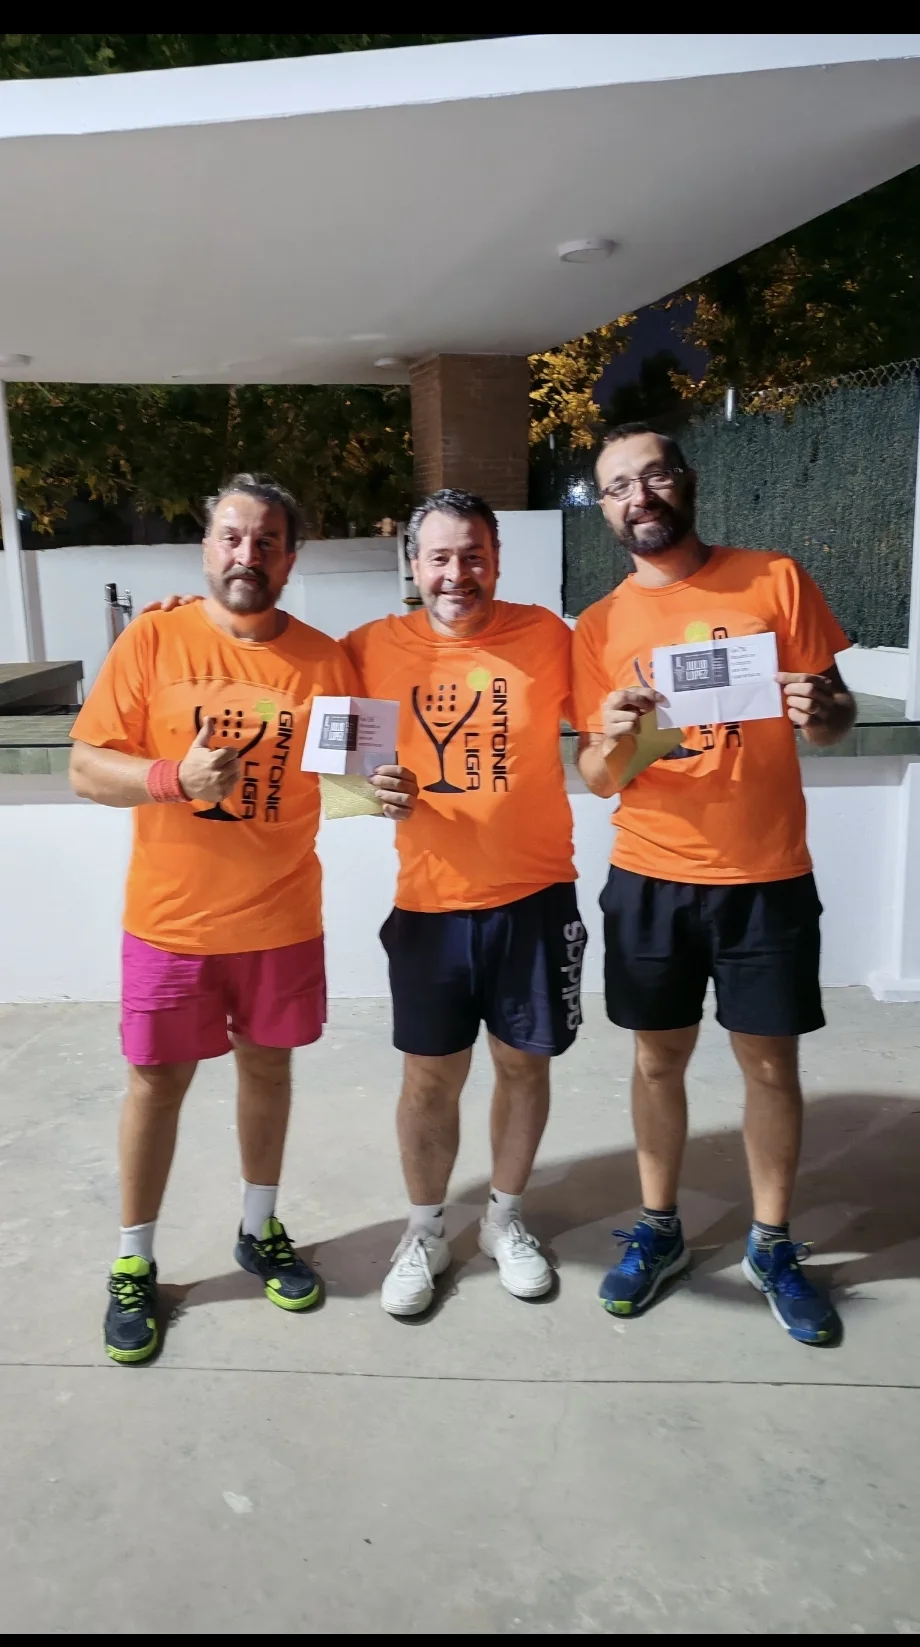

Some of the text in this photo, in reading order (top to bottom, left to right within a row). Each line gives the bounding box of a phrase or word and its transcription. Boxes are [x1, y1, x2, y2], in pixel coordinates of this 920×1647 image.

[241, 760, 260, 820] LIGA
[264, 710, 294, 823] GINTONIC
[464, 732, 481, 791] LIGA
[491, 677, 509, 793] GINTONIC
[560, 920, 586, 1031] adidas
